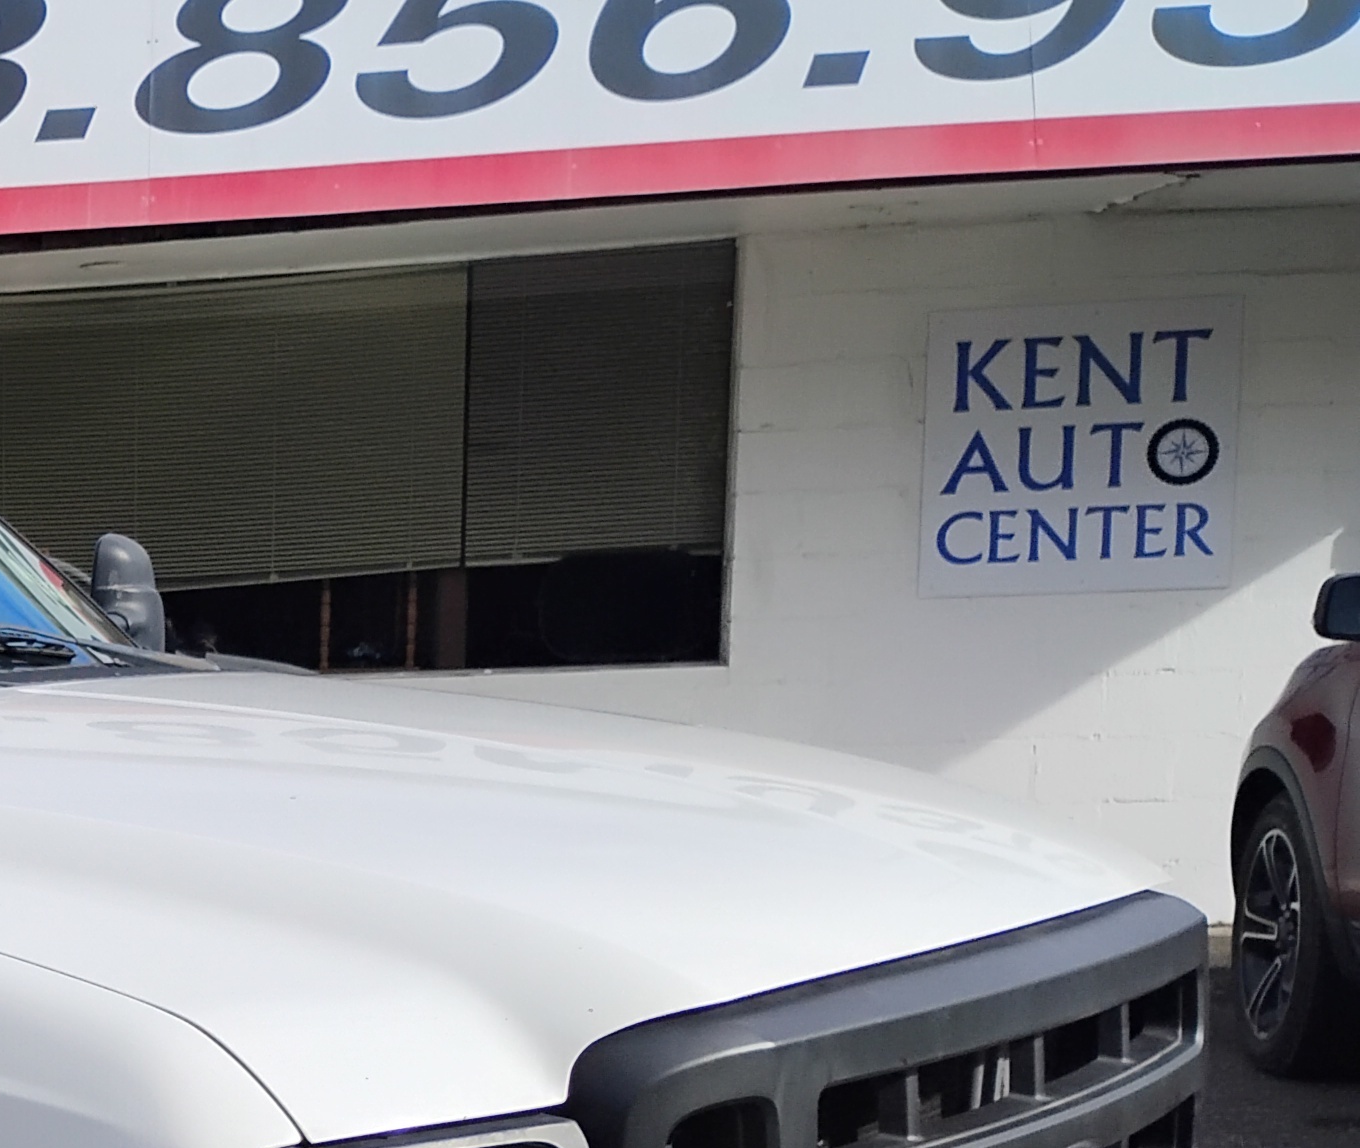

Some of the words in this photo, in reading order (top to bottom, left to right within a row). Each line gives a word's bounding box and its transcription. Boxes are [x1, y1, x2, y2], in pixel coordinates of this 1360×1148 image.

[952, 328, 1213, 413] KENT
[940, 419, 1220, 496] AUTO
[936, 503, 1214, 565] CENTER
